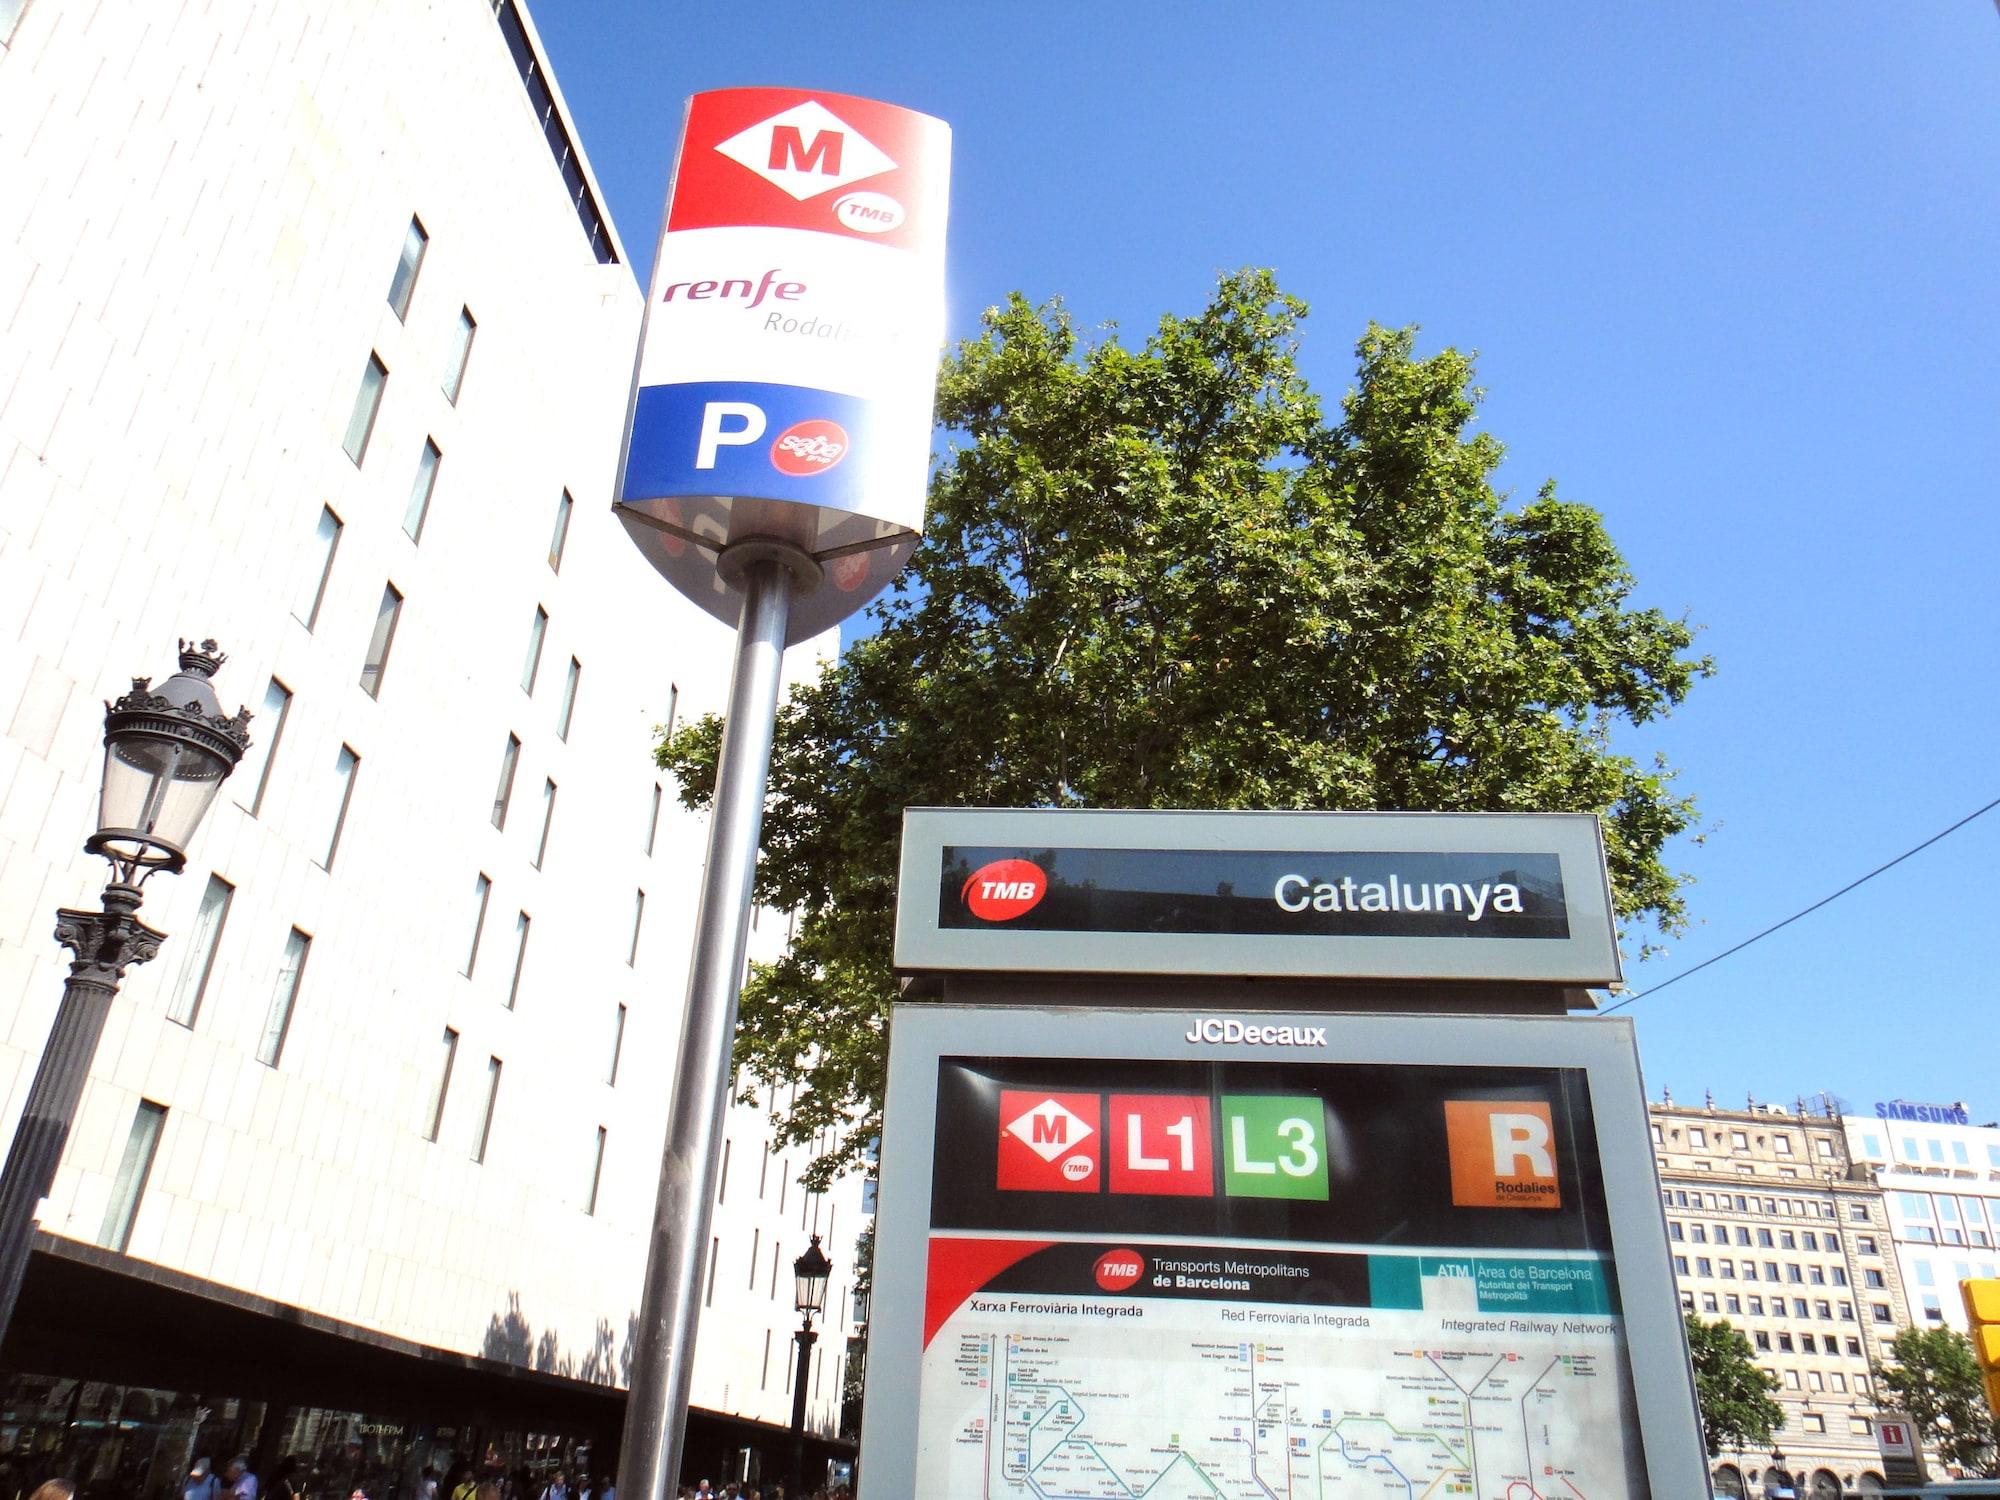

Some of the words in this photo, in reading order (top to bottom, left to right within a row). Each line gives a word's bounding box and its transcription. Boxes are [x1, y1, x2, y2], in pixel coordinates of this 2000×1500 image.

[768, 125, 844, 177] M
[848, 203, 894, 224] TMB
[663, 268, 806, 309] renfe
[696, 402, 767, 469] P
[981, 881, 1036, 900] TMB
[1274, 874, 1524, 921] Catalunya
[1186, 1019, 1328, 1047] JCDecaux
[1875, 1102, 1968, 1125] SAMSUNG
[1033, 1114, 1067, 1144] M
[1127, 1113, 1194, 1171] L1
[1231, 1115, 1318, 1177] L3
[1489, 1113, 1555, 1177] R
[1067, 1163, 1090, 1174] TMB
[1495, 1181, 1555, 1194] Rodalies
[1103, 1263, 1138, 1277] TMB
[1153, 1258, 1221, 1274] Transports
[1224, 1261, 1310, 1279] Metropolitans
[1437, 1264, 1469, 1278] ATM
[1477, 1263, 1506, 1279] Àrea
[1509, 1266, 1526, 1279] de
[1529, 1266, 1593, 1281] Barcelona
[1153, 1274, 1172, 1288] de
[1176, 1276, 1250, 1291] Barcelona
[1478, 1281, 1515, 1290] Autoritat
[1516, 1281, 1530, 1290] del
[1532, 1282, 1573, 1292] Transport
[970, 1300, 1006, 1313] Xarxa
[1010, 1301, 1078, 1315] Ferroviària
[1082, 1303, 1143, 1319] Integrada
[1221, 1309, 1245, 1322] Red
[1249, 1310, 1310, 1325] Ferroviaria
[1313, 1312, 1370, 1328] Integrada
[1441, 1318, 1506, 1334] Integrated
[1509, 1320, 1558, 1336] Railway
[1562, 1321, 1617, 1336] Network
